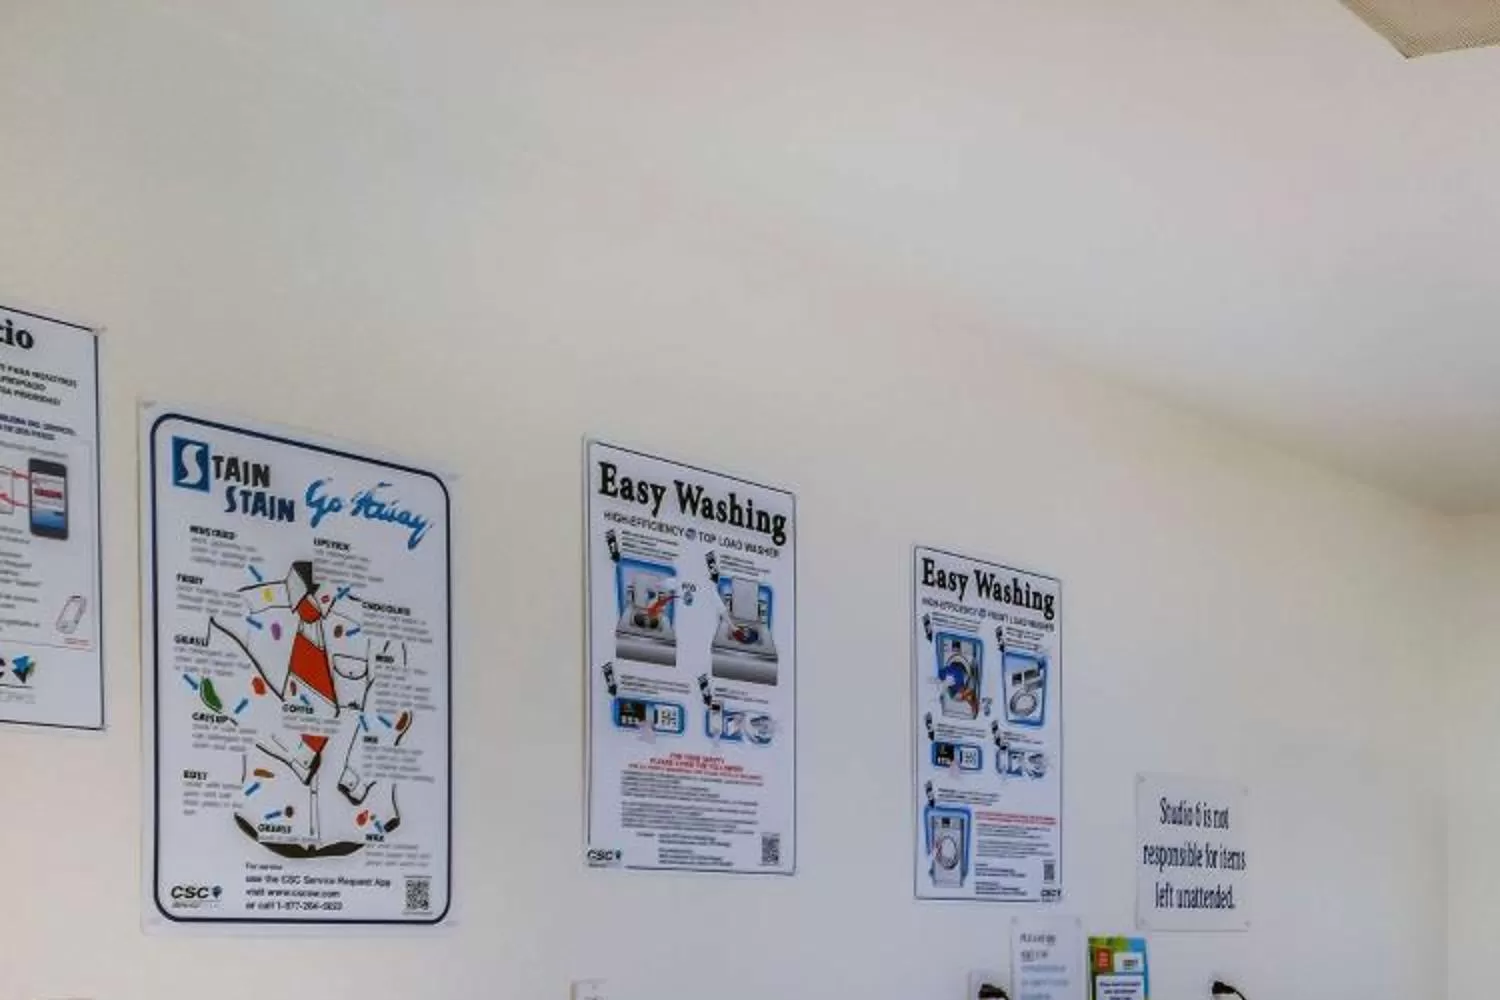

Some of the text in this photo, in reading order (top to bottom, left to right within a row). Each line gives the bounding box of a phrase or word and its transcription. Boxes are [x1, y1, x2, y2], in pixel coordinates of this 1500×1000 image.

[0, 319, 34, 349] io
[224, 486, 296, 523] STAIN
[305, 478, 343, 529] Go
[598, 461, 667, 518] Easy
[673, 479, 787, 546] Washing
[699, 531, 717, 544] TOP
[720, 536, 744, 551] LOAD
[922, 557, 1055, 621] Easy Washing
[1160, 797, 1229, 830] Studio 6 is not
[587, 850, 613, 861] CSC
[1143, 841, 1246, 872] responsible for items
[171, 885, 210, 899] CSC
[264, 875, 279, 884] the
[1155, 882, 1236, 909] left unattended.
